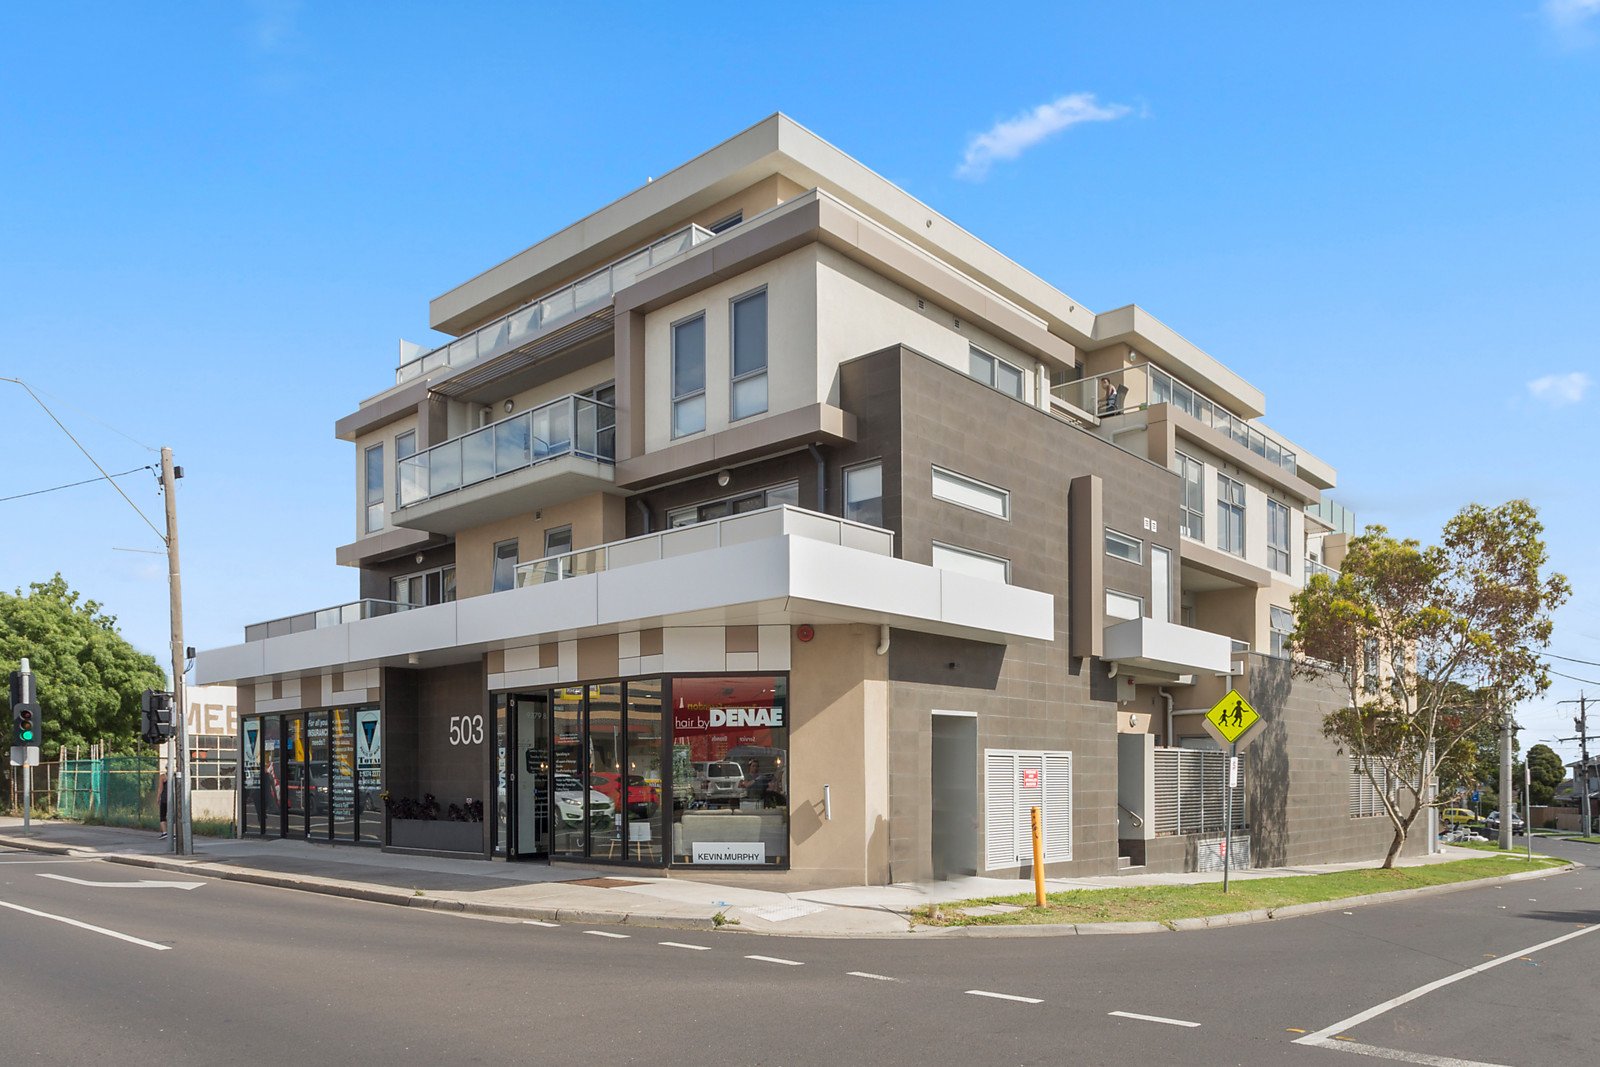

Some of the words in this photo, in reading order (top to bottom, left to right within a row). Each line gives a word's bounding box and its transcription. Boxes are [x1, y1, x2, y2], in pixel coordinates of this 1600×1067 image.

[675, 716, 694, 727] hair
[697, 716, 710, 730] by
[709, 708, 782, 727] DENAE
[308, 729, 328, 737] INSURANC
[449, 715, 484, 745] 503
[697, 853, 760, 861] KEVIN.MURPHY
